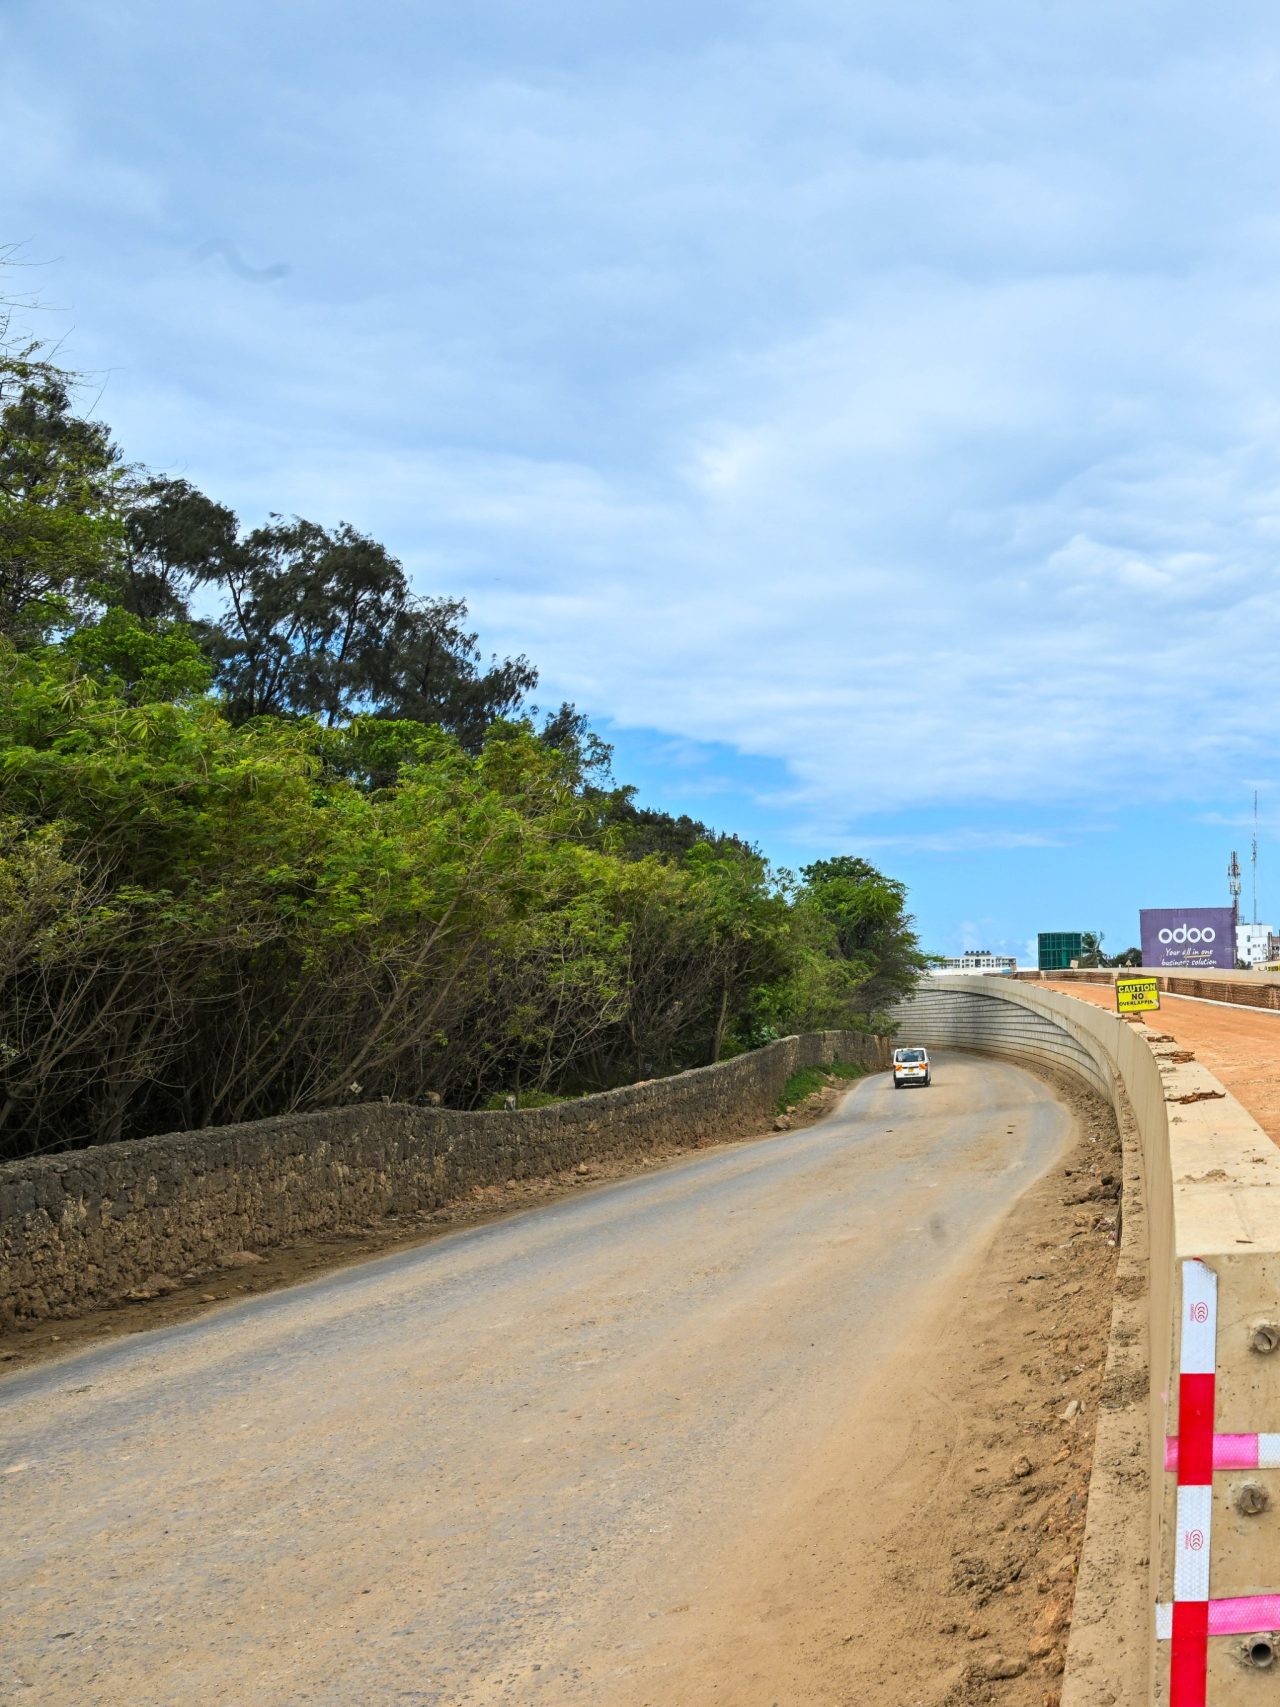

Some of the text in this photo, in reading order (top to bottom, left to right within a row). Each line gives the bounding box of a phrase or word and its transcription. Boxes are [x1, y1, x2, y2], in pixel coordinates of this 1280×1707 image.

[1158, 923, 1216, 944] odoo
[1165, 947, 1180, 956] Your
[1191, 957, 1217, 966] solution
[1118, 984, 1156, 993] CAUTION
